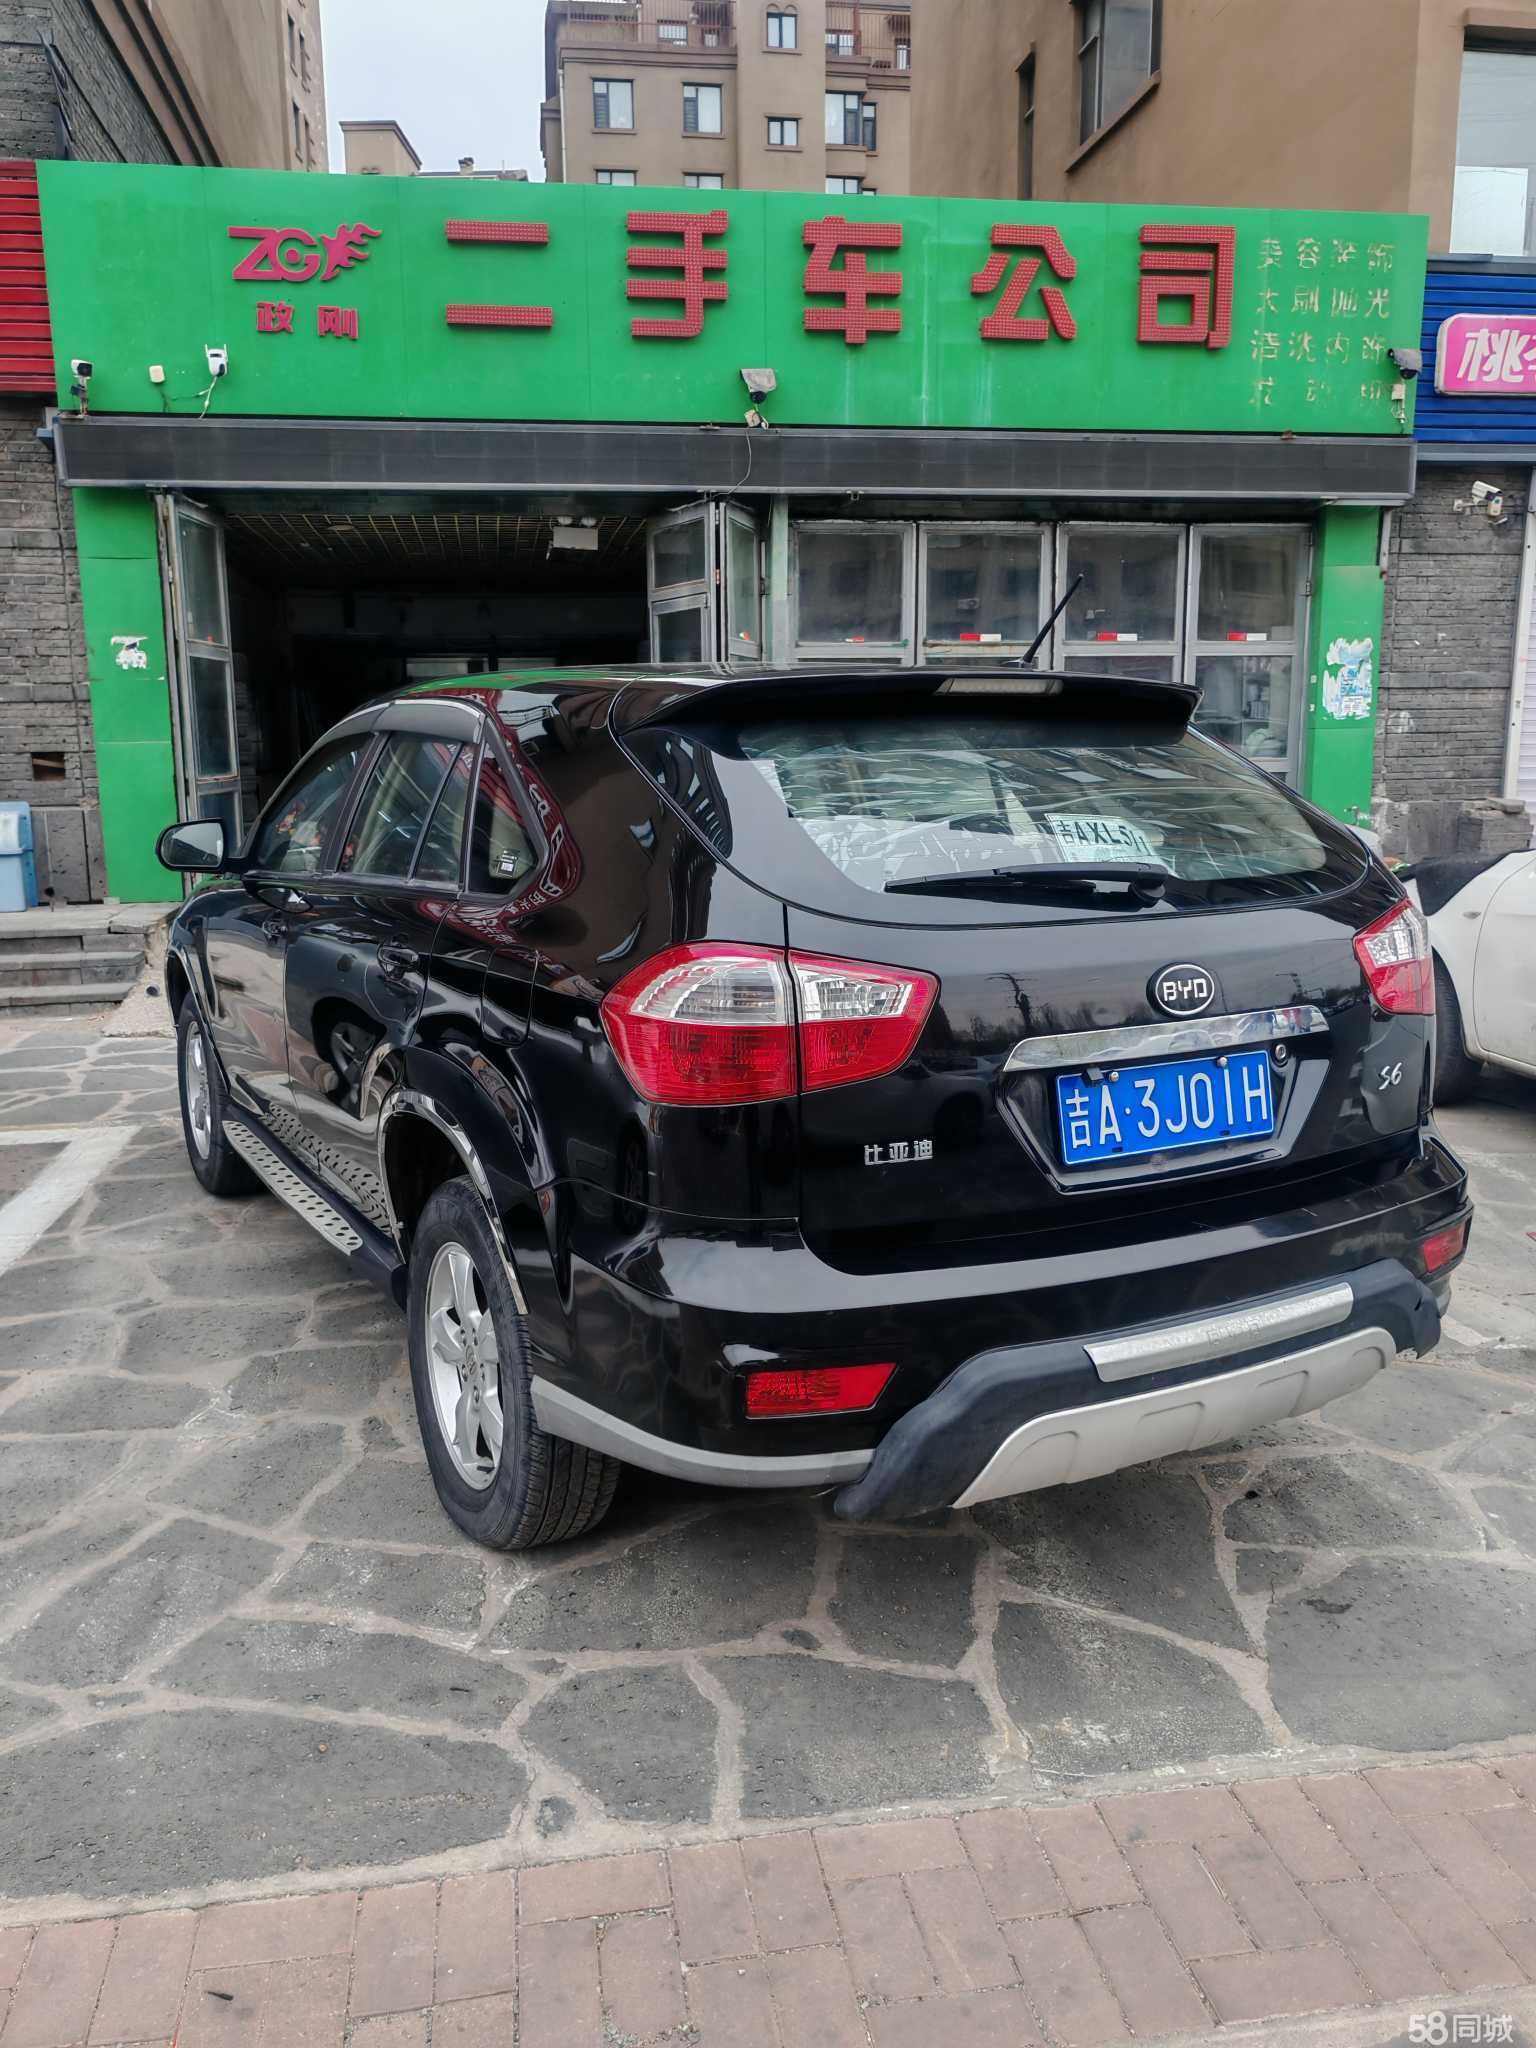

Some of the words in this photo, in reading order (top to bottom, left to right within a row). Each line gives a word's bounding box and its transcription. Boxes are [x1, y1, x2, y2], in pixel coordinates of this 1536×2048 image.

[445, 209, 1236, 348] 二手车公司
[256, 301, 359, 340] 政刚
[1456, 328, 1536, 383] 桃
[1162, 977, 1209, 1001] BYD
[1378, 1062, 1403, 1091] S6
[864, 1139, 934, 1166] 比亚迪
